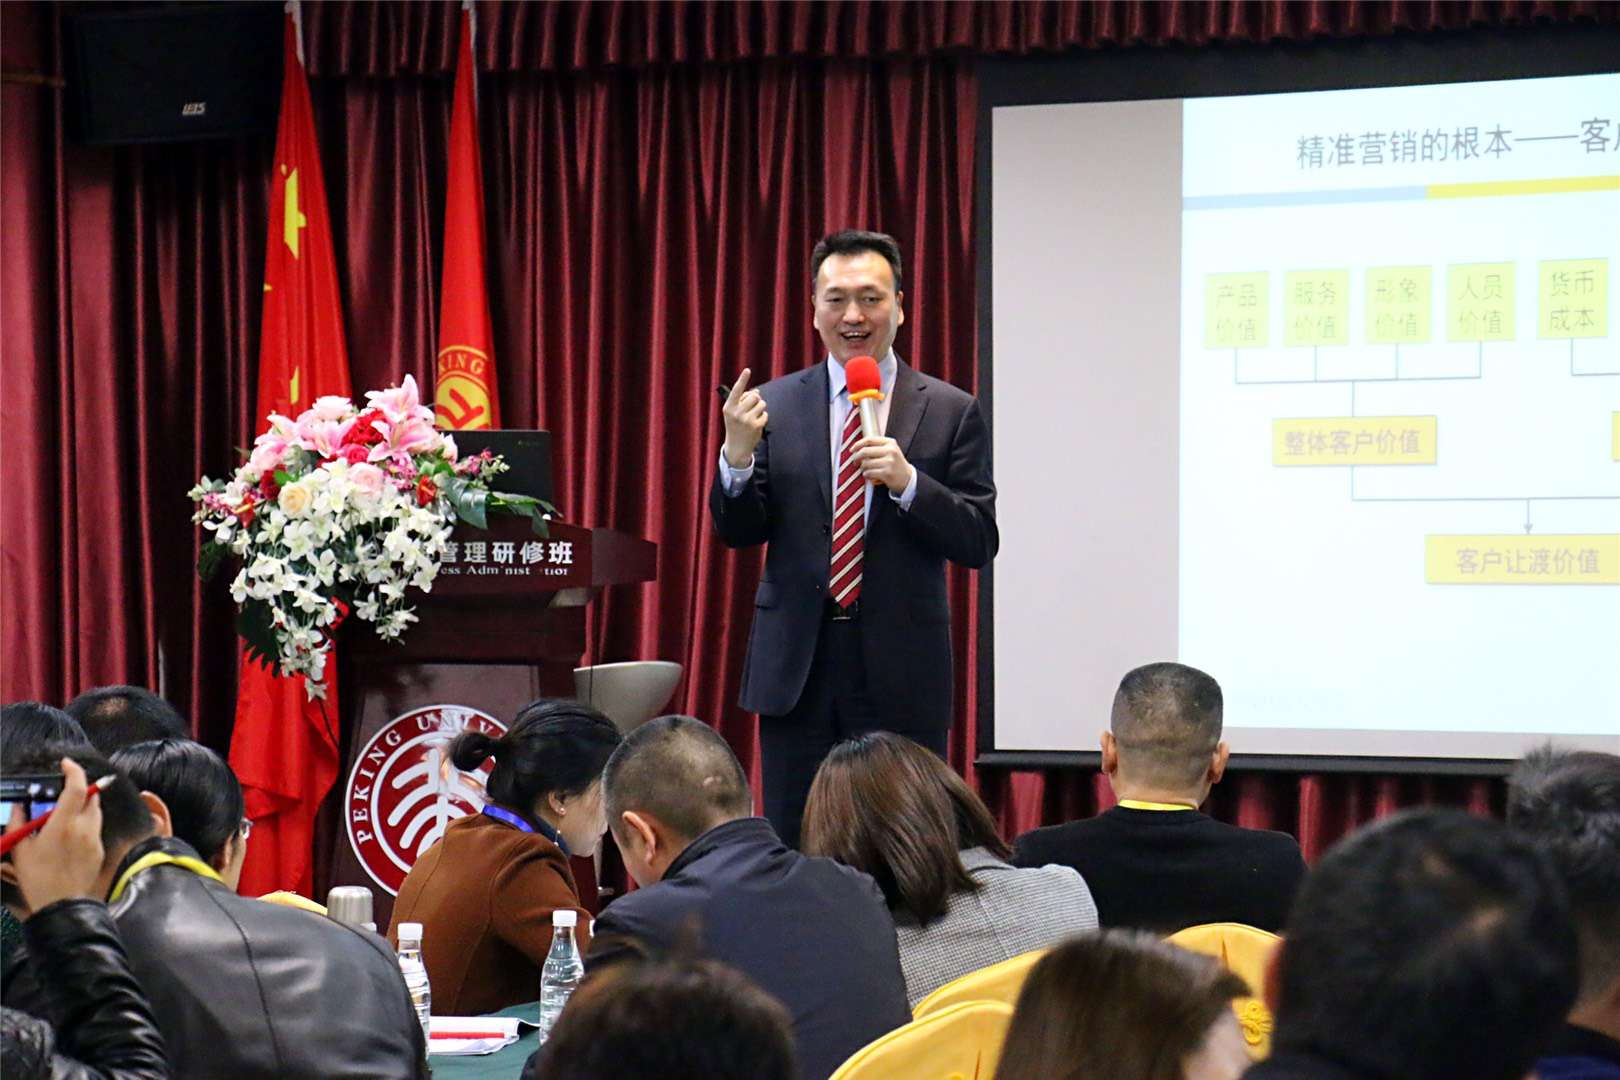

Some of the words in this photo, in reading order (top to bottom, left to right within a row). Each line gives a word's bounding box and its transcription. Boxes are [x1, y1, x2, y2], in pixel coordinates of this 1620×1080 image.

[1297, 115, 1620, 169] 精准营销的根本——客
[1458, 273, 1503, 300] 人员
[1551, 269, 1596, 297] 货币
[1458, 308, 1503, 335] 价值
[1550, 304, 1595, 331] 成本
[1285, 429, 1420, 456] 整体客户价值
[1456, 548, 1600, 575] 客户让渡价值
[353, 729, 402, 845] PEKING
